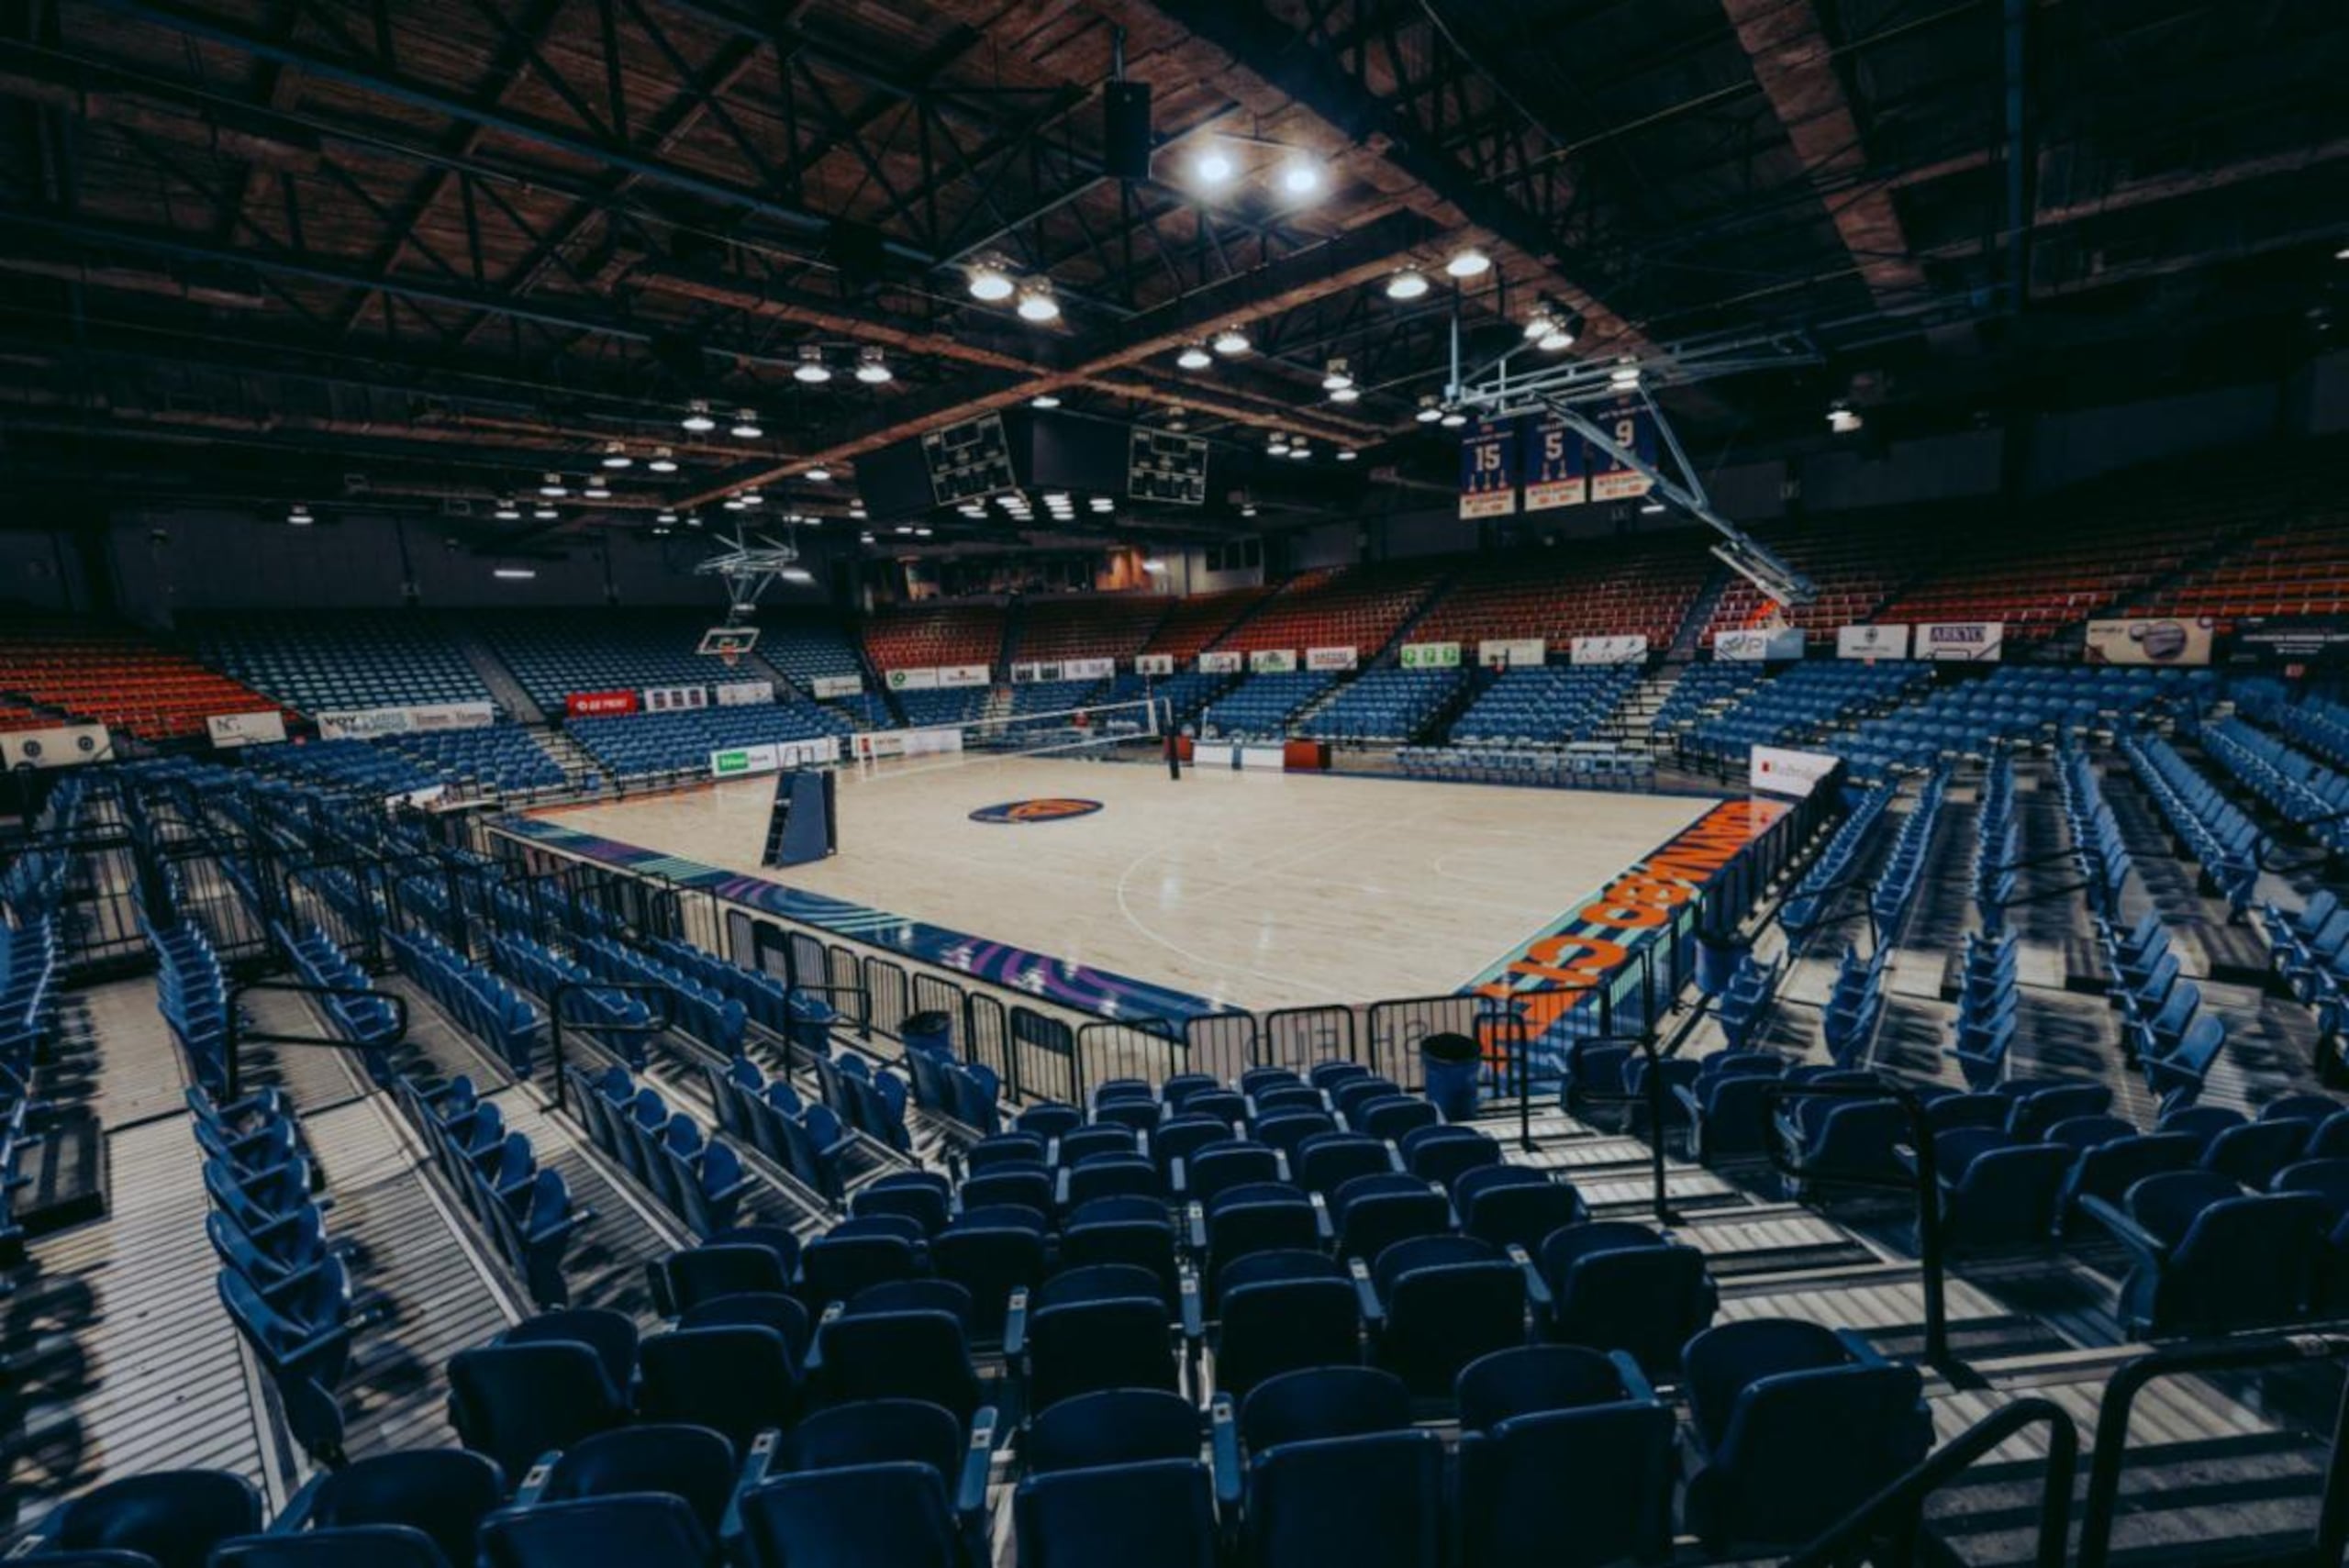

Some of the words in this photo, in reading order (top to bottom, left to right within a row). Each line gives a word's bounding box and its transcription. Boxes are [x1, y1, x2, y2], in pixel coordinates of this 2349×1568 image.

[1544, 431, 1564, 461] 5
[1615, 419, 1634, 448] 9
[1475, 442, 1501, 472] 15
[1578, 796, 1797, 929] GUAYNABO
